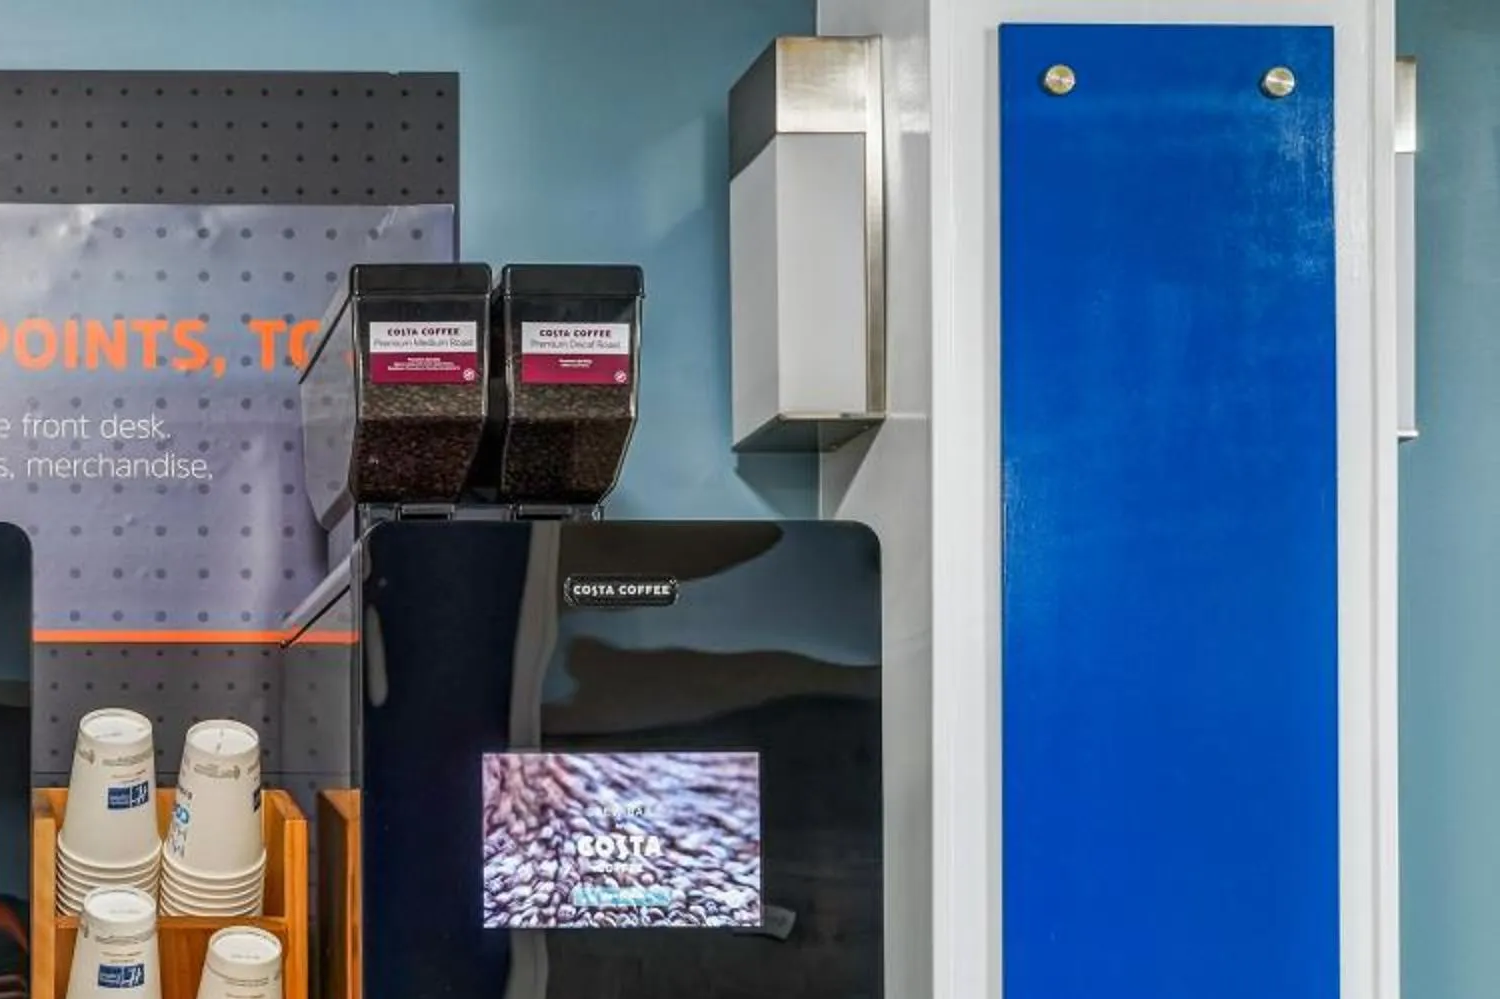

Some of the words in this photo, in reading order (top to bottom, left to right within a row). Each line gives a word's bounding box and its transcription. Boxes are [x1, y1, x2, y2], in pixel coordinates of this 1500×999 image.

[421, 327, 460, 336] COFFEE
[573, 329, 611, 338] COFFEE
[22, 412, 89, 439] front
[100, 412, 172, 439] desk.
[26, 452, 214, 482] merchandise,
[573, 584, 615, 597] COSTA
[619, 585, 671, 595] COFFEE
[577, 834, 664, 860] COSTA
